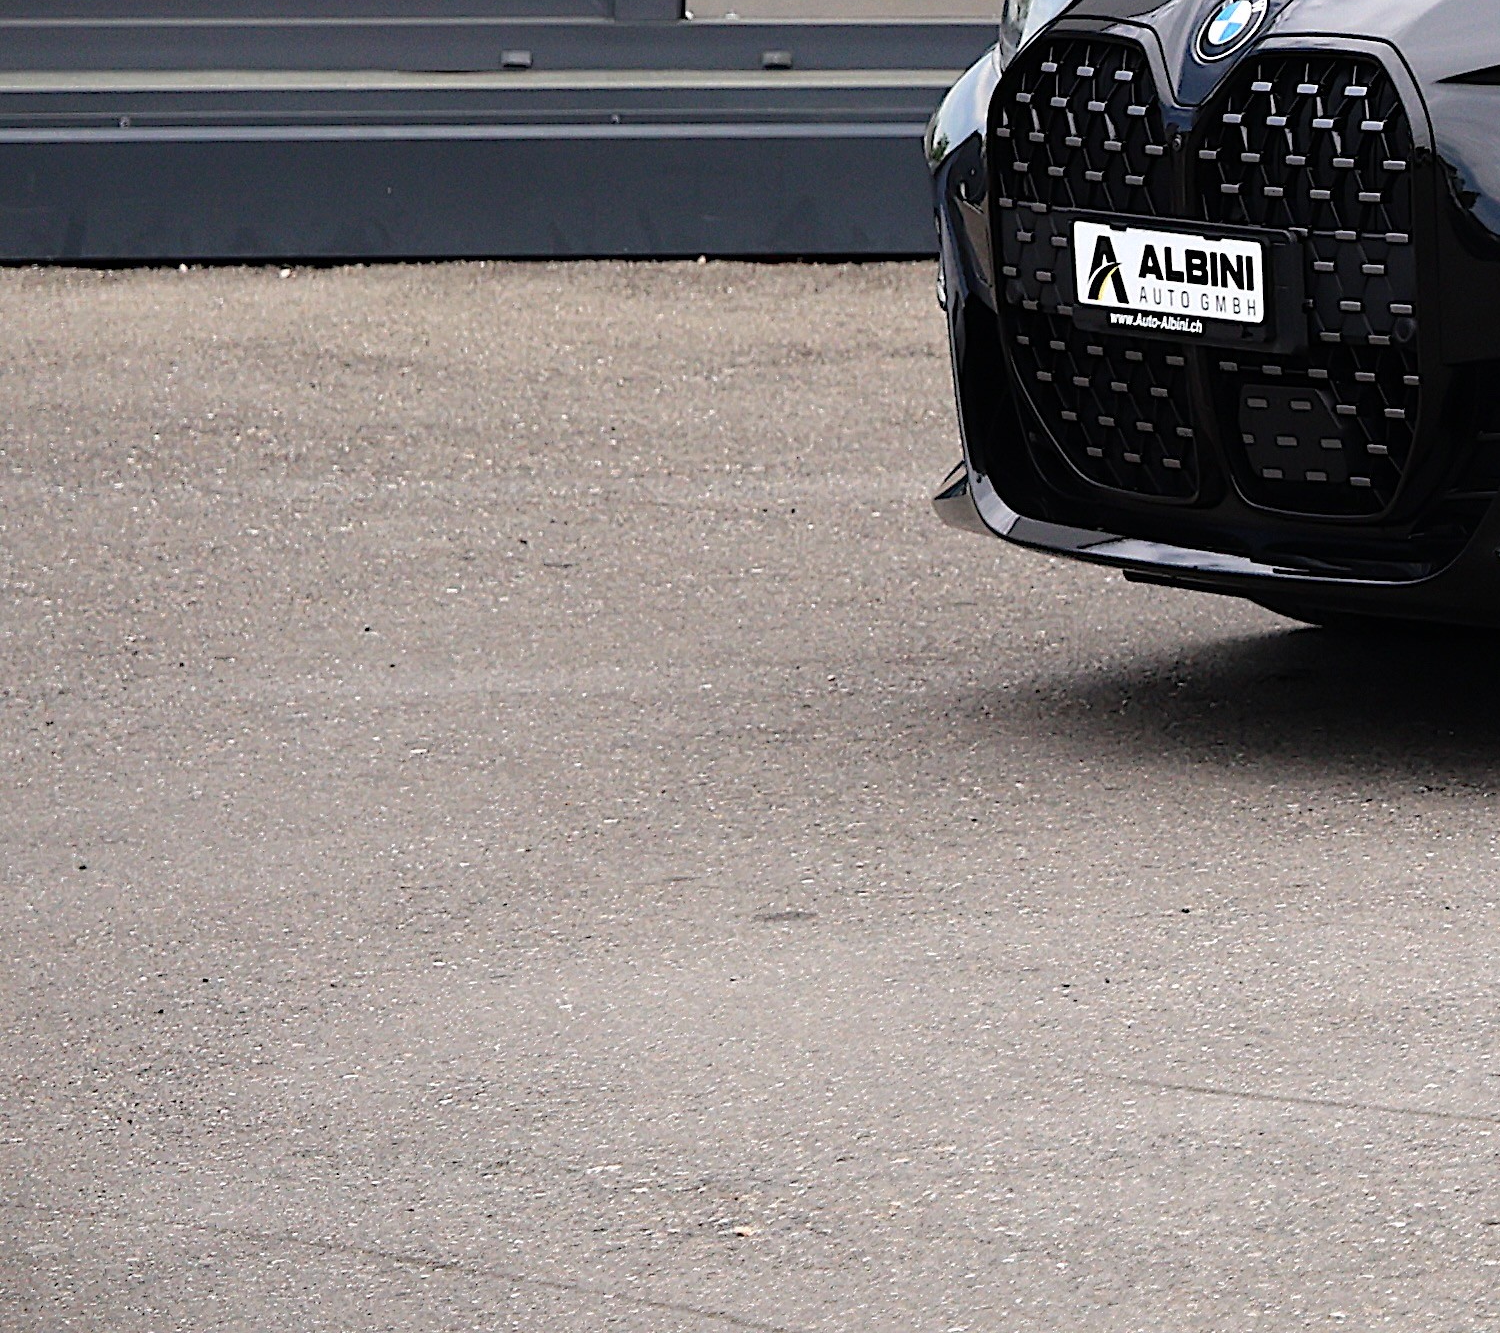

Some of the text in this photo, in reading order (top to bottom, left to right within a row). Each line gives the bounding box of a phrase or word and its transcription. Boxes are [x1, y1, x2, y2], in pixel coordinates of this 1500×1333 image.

[1138, 244, 1255, 291] ALBINI
[1139, 286, 1257, 317] AUTO GMBH
[1110, 312, 1203, 333] www.Auto-Albini.ch
